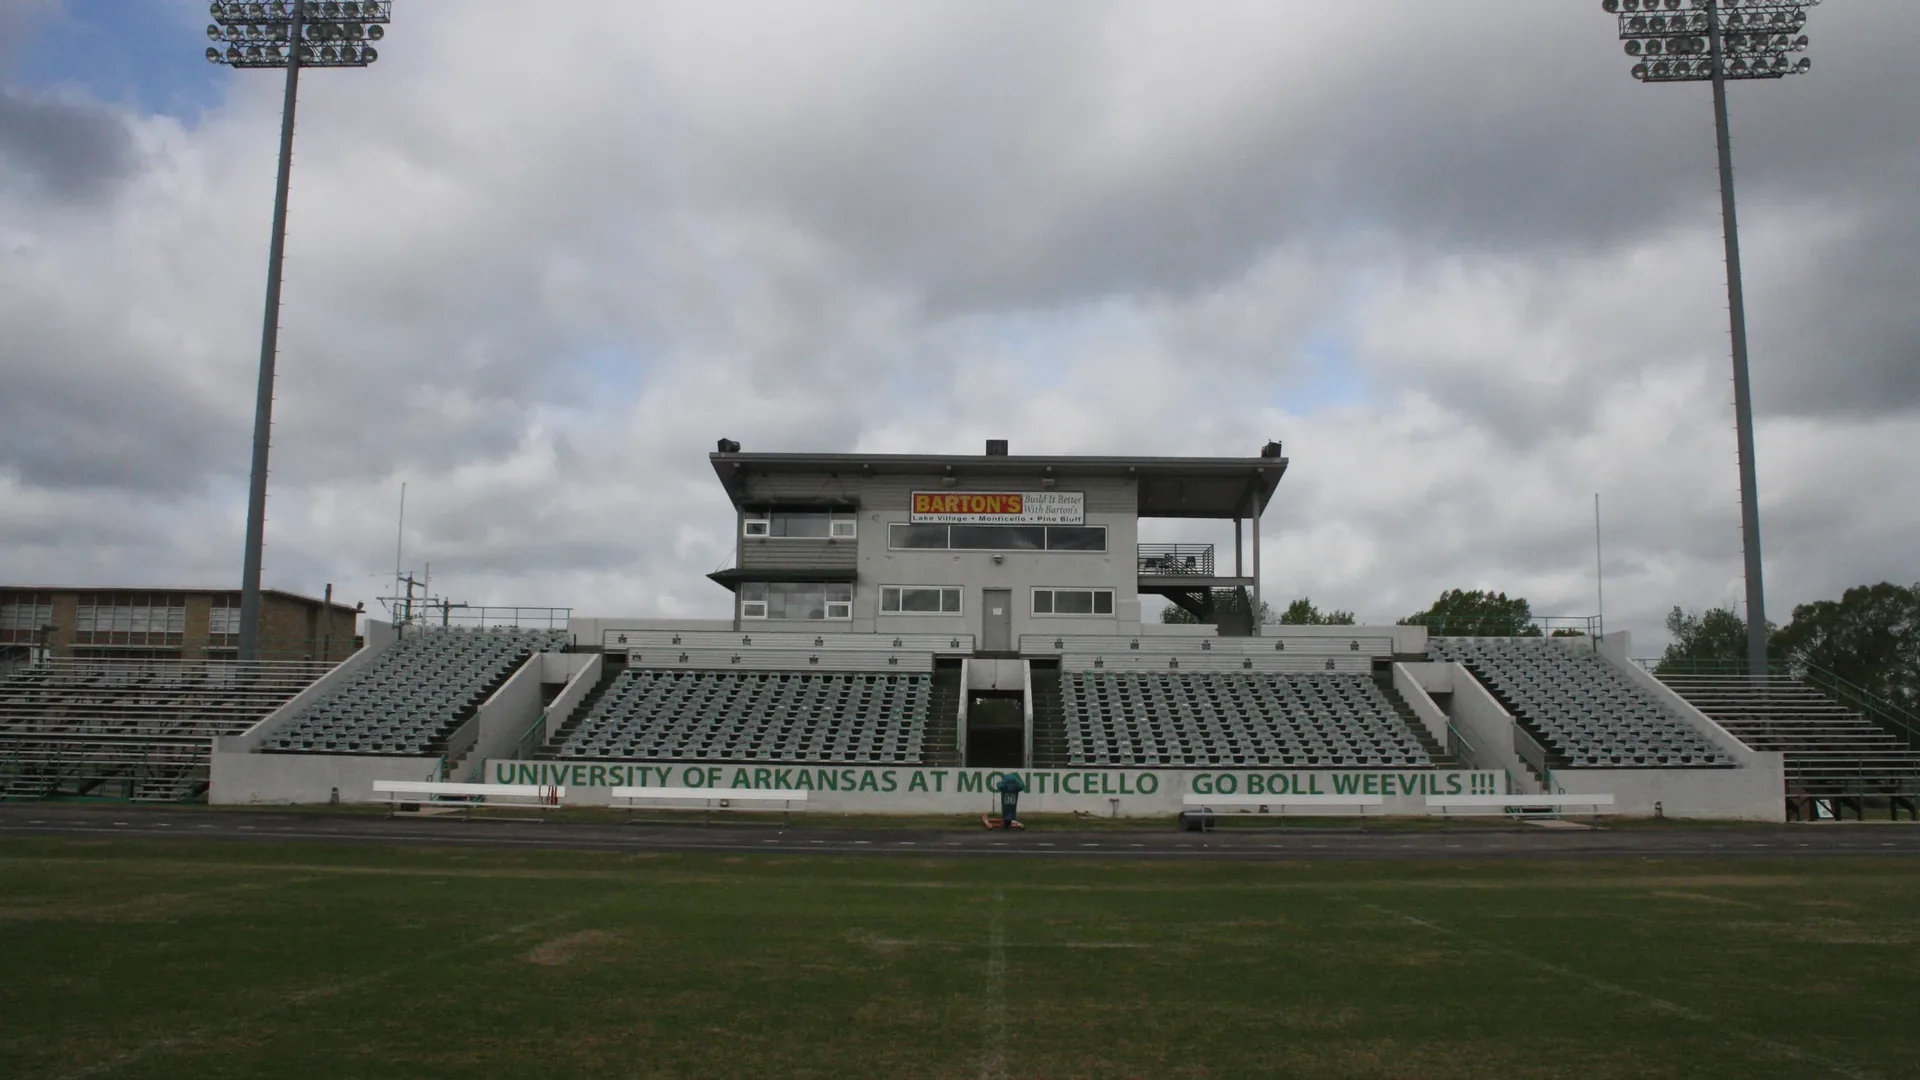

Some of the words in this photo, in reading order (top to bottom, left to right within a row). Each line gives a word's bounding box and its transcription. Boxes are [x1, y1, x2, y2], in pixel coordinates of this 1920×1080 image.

[917, 496, 1021, 513] BARTON'S
[1024, 495, 1046, 504] Build
[1048, 495, 1056, 504] It
[1058, 495, 1082, 504] Better
[1024, 505, 1044, 514] With
[1045, 505, 1078, 514] Barton's
[496, 763, 673, 788] UNIVERSITY
[682, 766, 723, 788] OF
[731, 767, 898, 792] ARKANSAS
[908, 770, 949, 793] AT
[1192, 773, 1238, 795] GO
[1247, 773, 1325, 795] BOLL
[1332, 773, 1462, 796] WEEVILS
